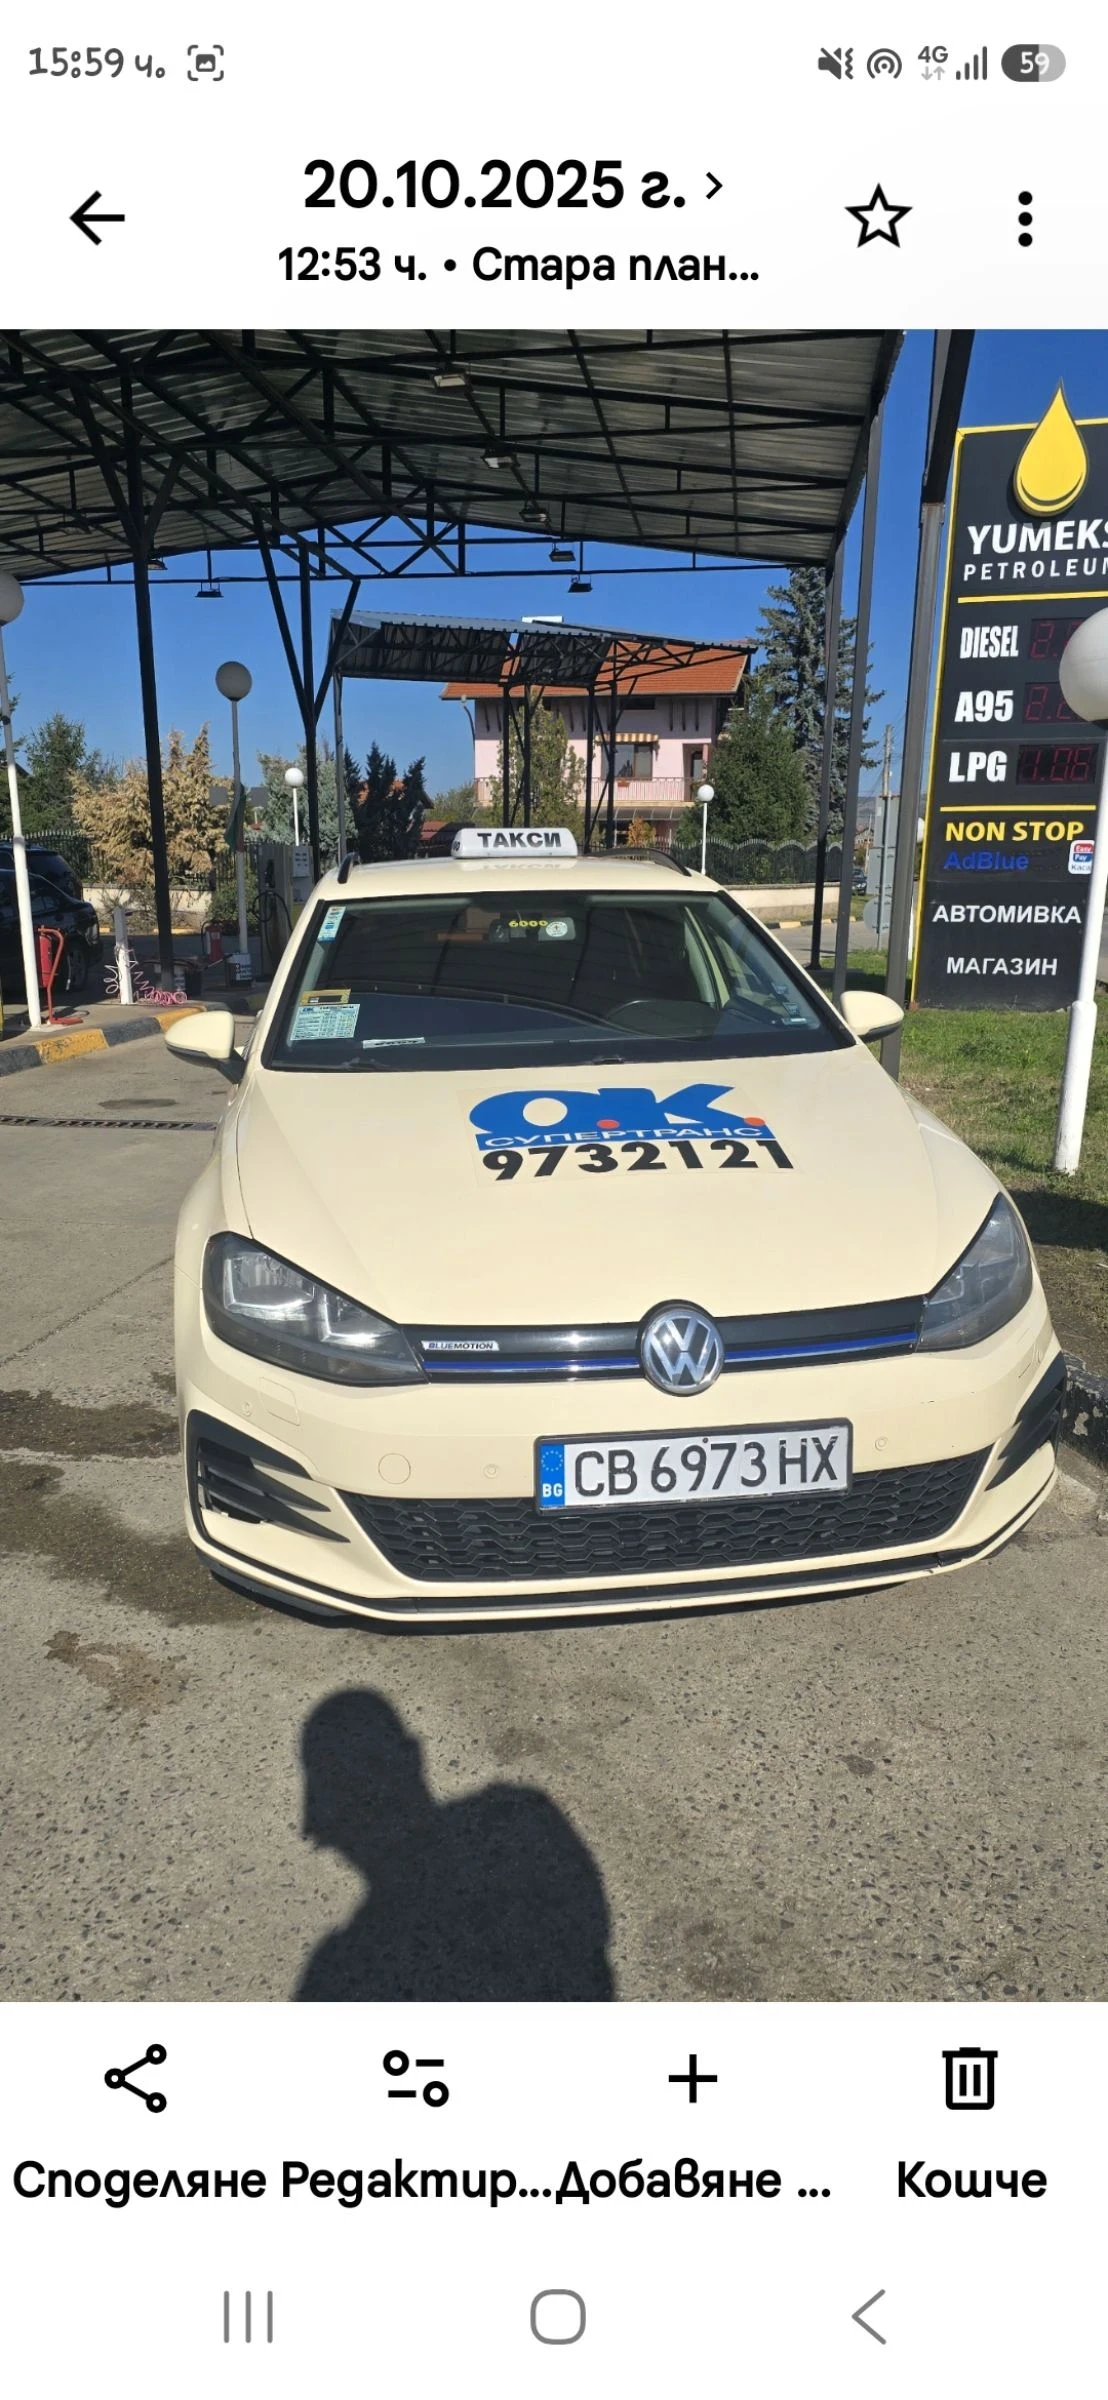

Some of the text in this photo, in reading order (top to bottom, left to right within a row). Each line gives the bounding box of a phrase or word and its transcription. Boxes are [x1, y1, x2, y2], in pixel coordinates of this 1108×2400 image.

[960, 625, 1019, 659] DIESEL
[954, 690, 1014, 723] A95
[949, 751, 1008, 783] LPG
[477, 832, 562, 848] ТАКСИ
[945, 821, 1084, 841] NON STOP
[943, 852, 1030, 871] AdBlue
[508, 920, 548, 928] 6000
[932, 904, 1082, 925] АВТОМИВКА
[946, 957, 1058, 976] МАГАЗИН
[484, 1127, 763, 1148] СУПЕРТРАНС
[482, 1139, 794, 1181] 9732121
[575, 1436, 839, 1497] CB 6973 HX
[542, 1483, 563, 1498] BG
